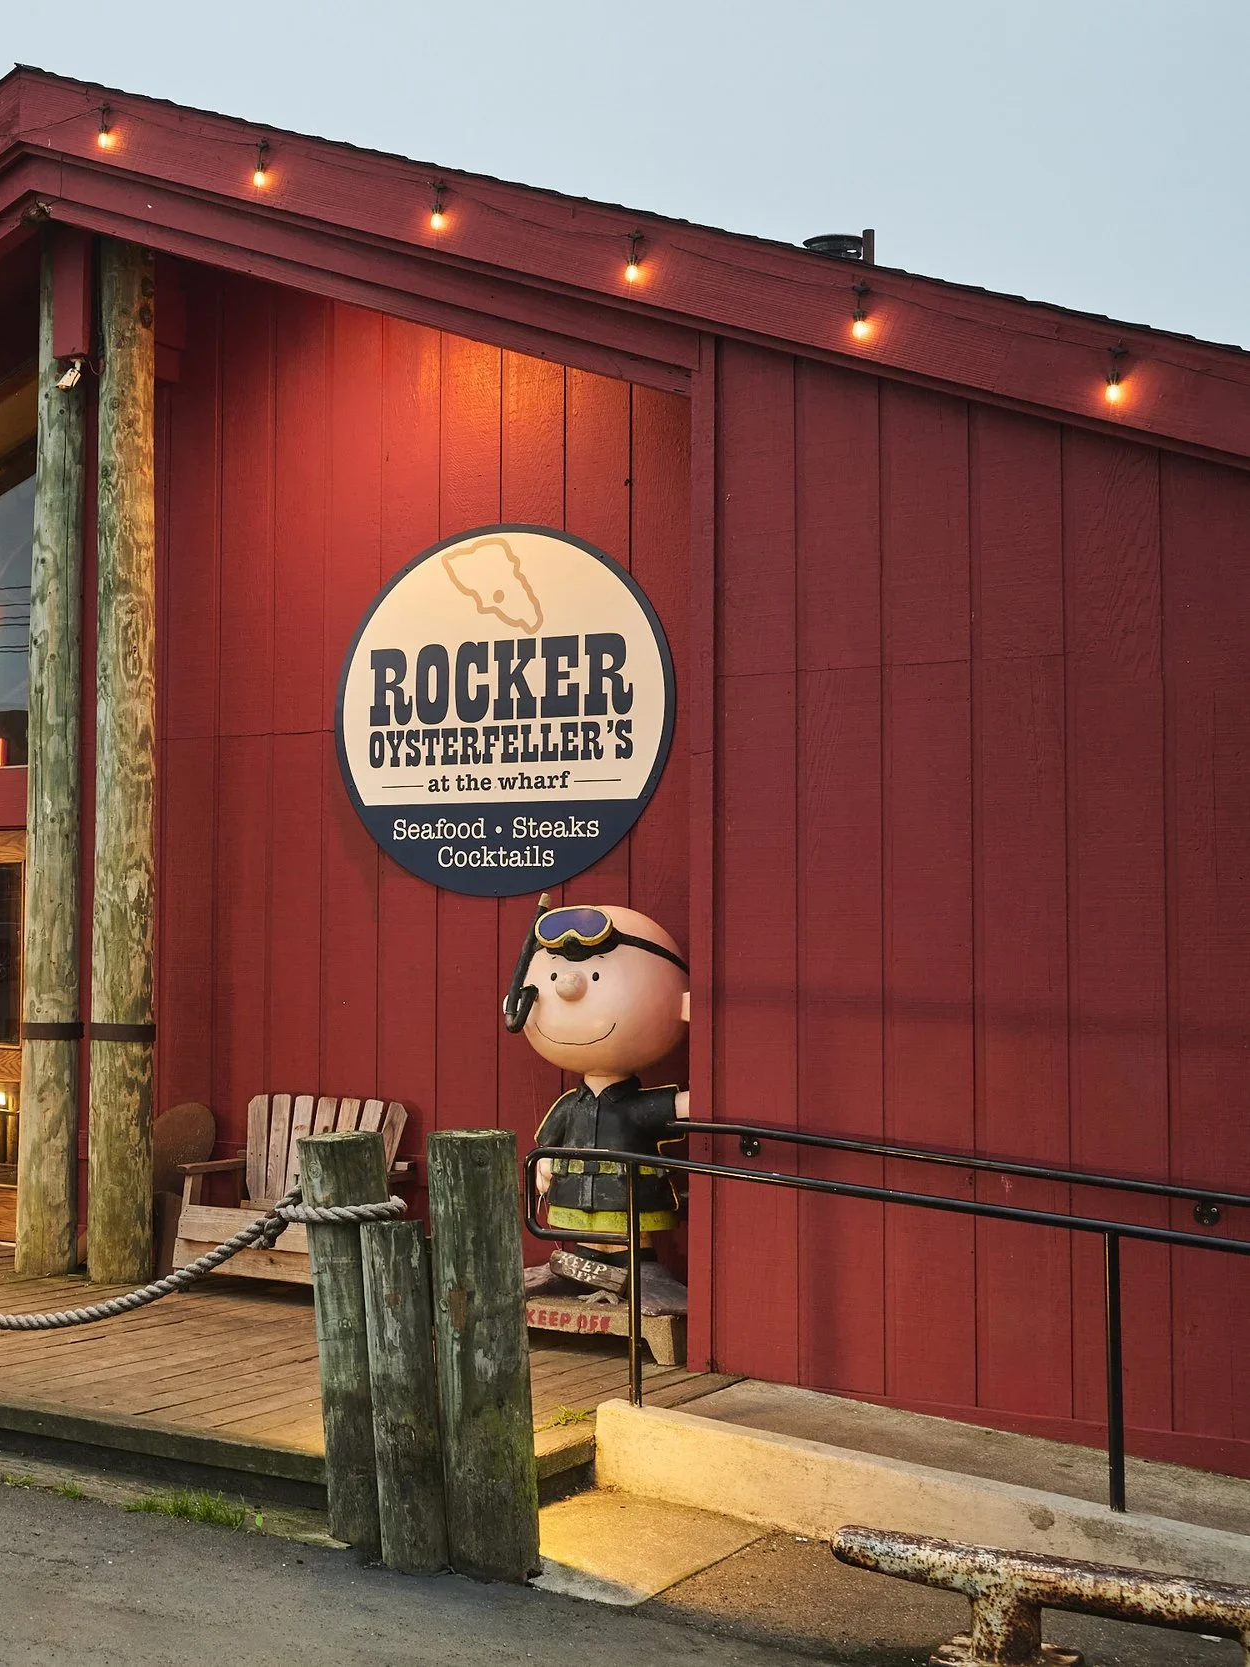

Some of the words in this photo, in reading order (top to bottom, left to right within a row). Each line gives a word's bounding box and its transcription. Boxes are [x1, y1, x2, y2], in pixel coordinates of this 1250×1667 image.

[370, 633, 633, 726] ROCKER
[369, 719, 633, 768] OYSTERFELLER'S
[428, 778, 450, 793] at
[456, 774, 492, 791] the
[498, 771, 571, 790] wharf
[393, 818, 487, 840] Seafood
[512, 816, 600, 839] Steaks
[437, 846, 555, 868] Cocktails
[557, 1252, 608, 1275] KEEP
[526, 1308, 572, 1328] KEEP
